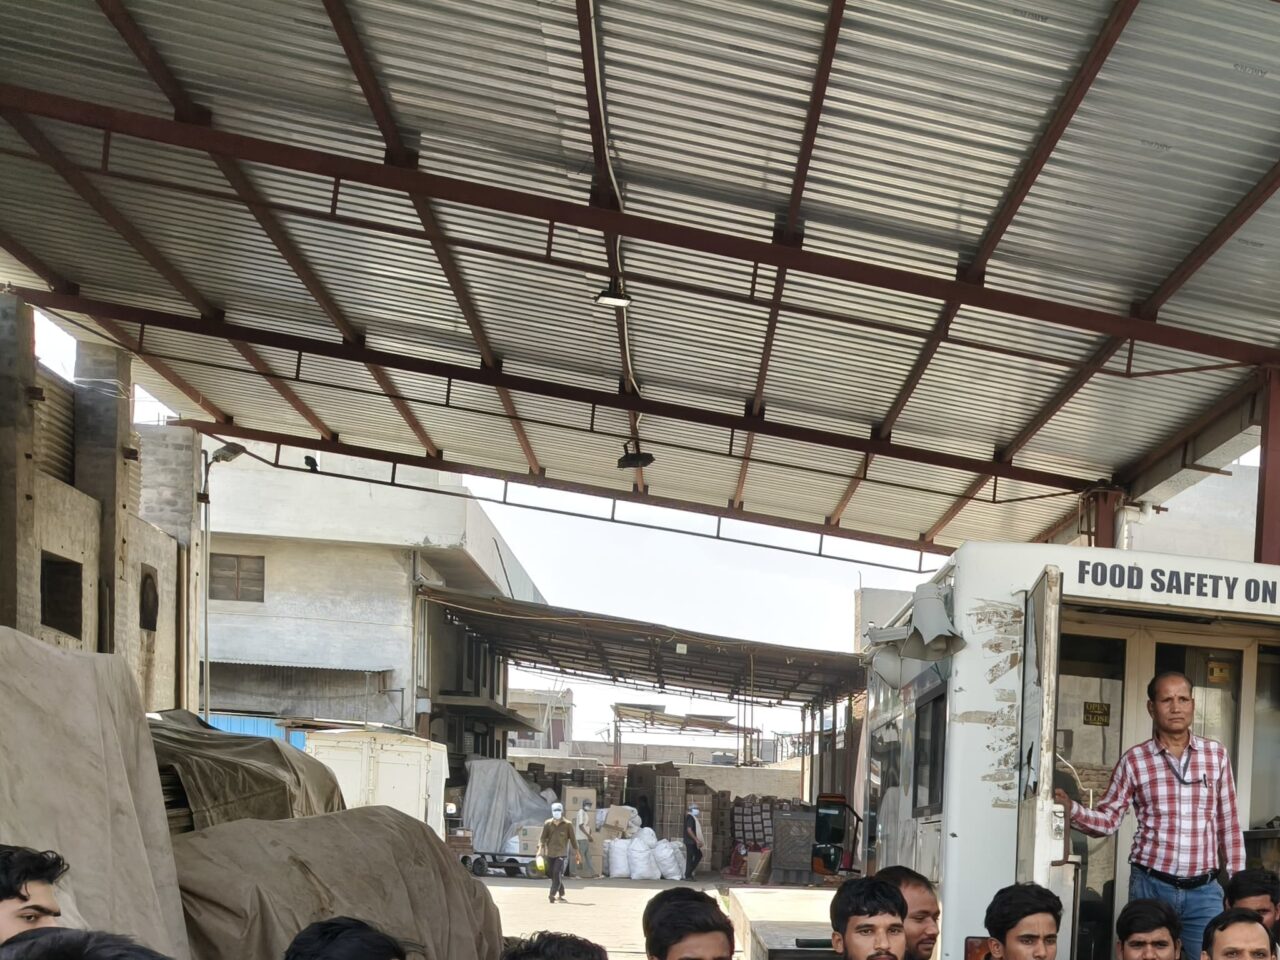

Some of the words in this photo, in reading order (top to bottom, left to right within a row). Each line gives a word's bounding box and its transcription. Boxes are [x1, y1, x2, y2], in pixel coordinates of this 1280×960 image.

[1077, 560, 1144, 590] FOOD
[1150, 568, 1238, 600] SAFETY
[1244, 578, 1277, 604] ON
[1086, 702, 1108, 712] OPEN
[1084, 714, 1109, 723] CLOSE
